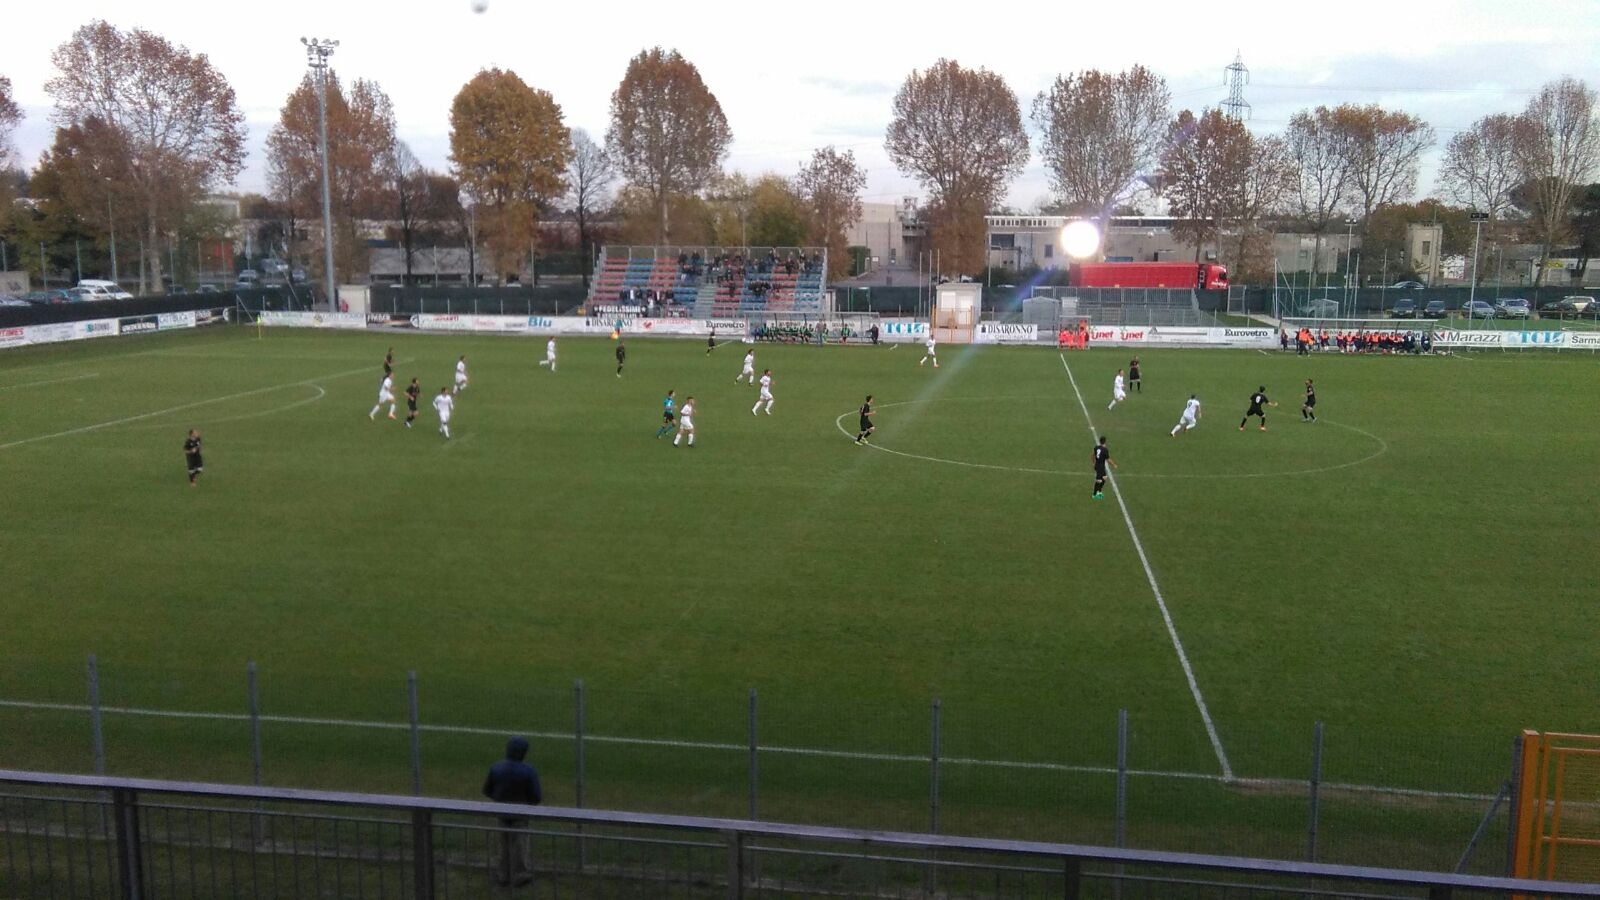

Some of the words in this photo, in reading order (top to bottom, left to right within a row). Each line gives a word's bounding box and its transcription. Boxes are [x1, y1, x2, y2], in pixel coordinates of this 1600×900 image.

[528, 316, 552, 328] Blu
[705, 320, 745, 329] Eurovetro
[988, 324, 1033, 334] DISARONNO
[1224, 329, 1268, 338] Eurovetro
[1446, 331, 1502, 343] Marazzi
